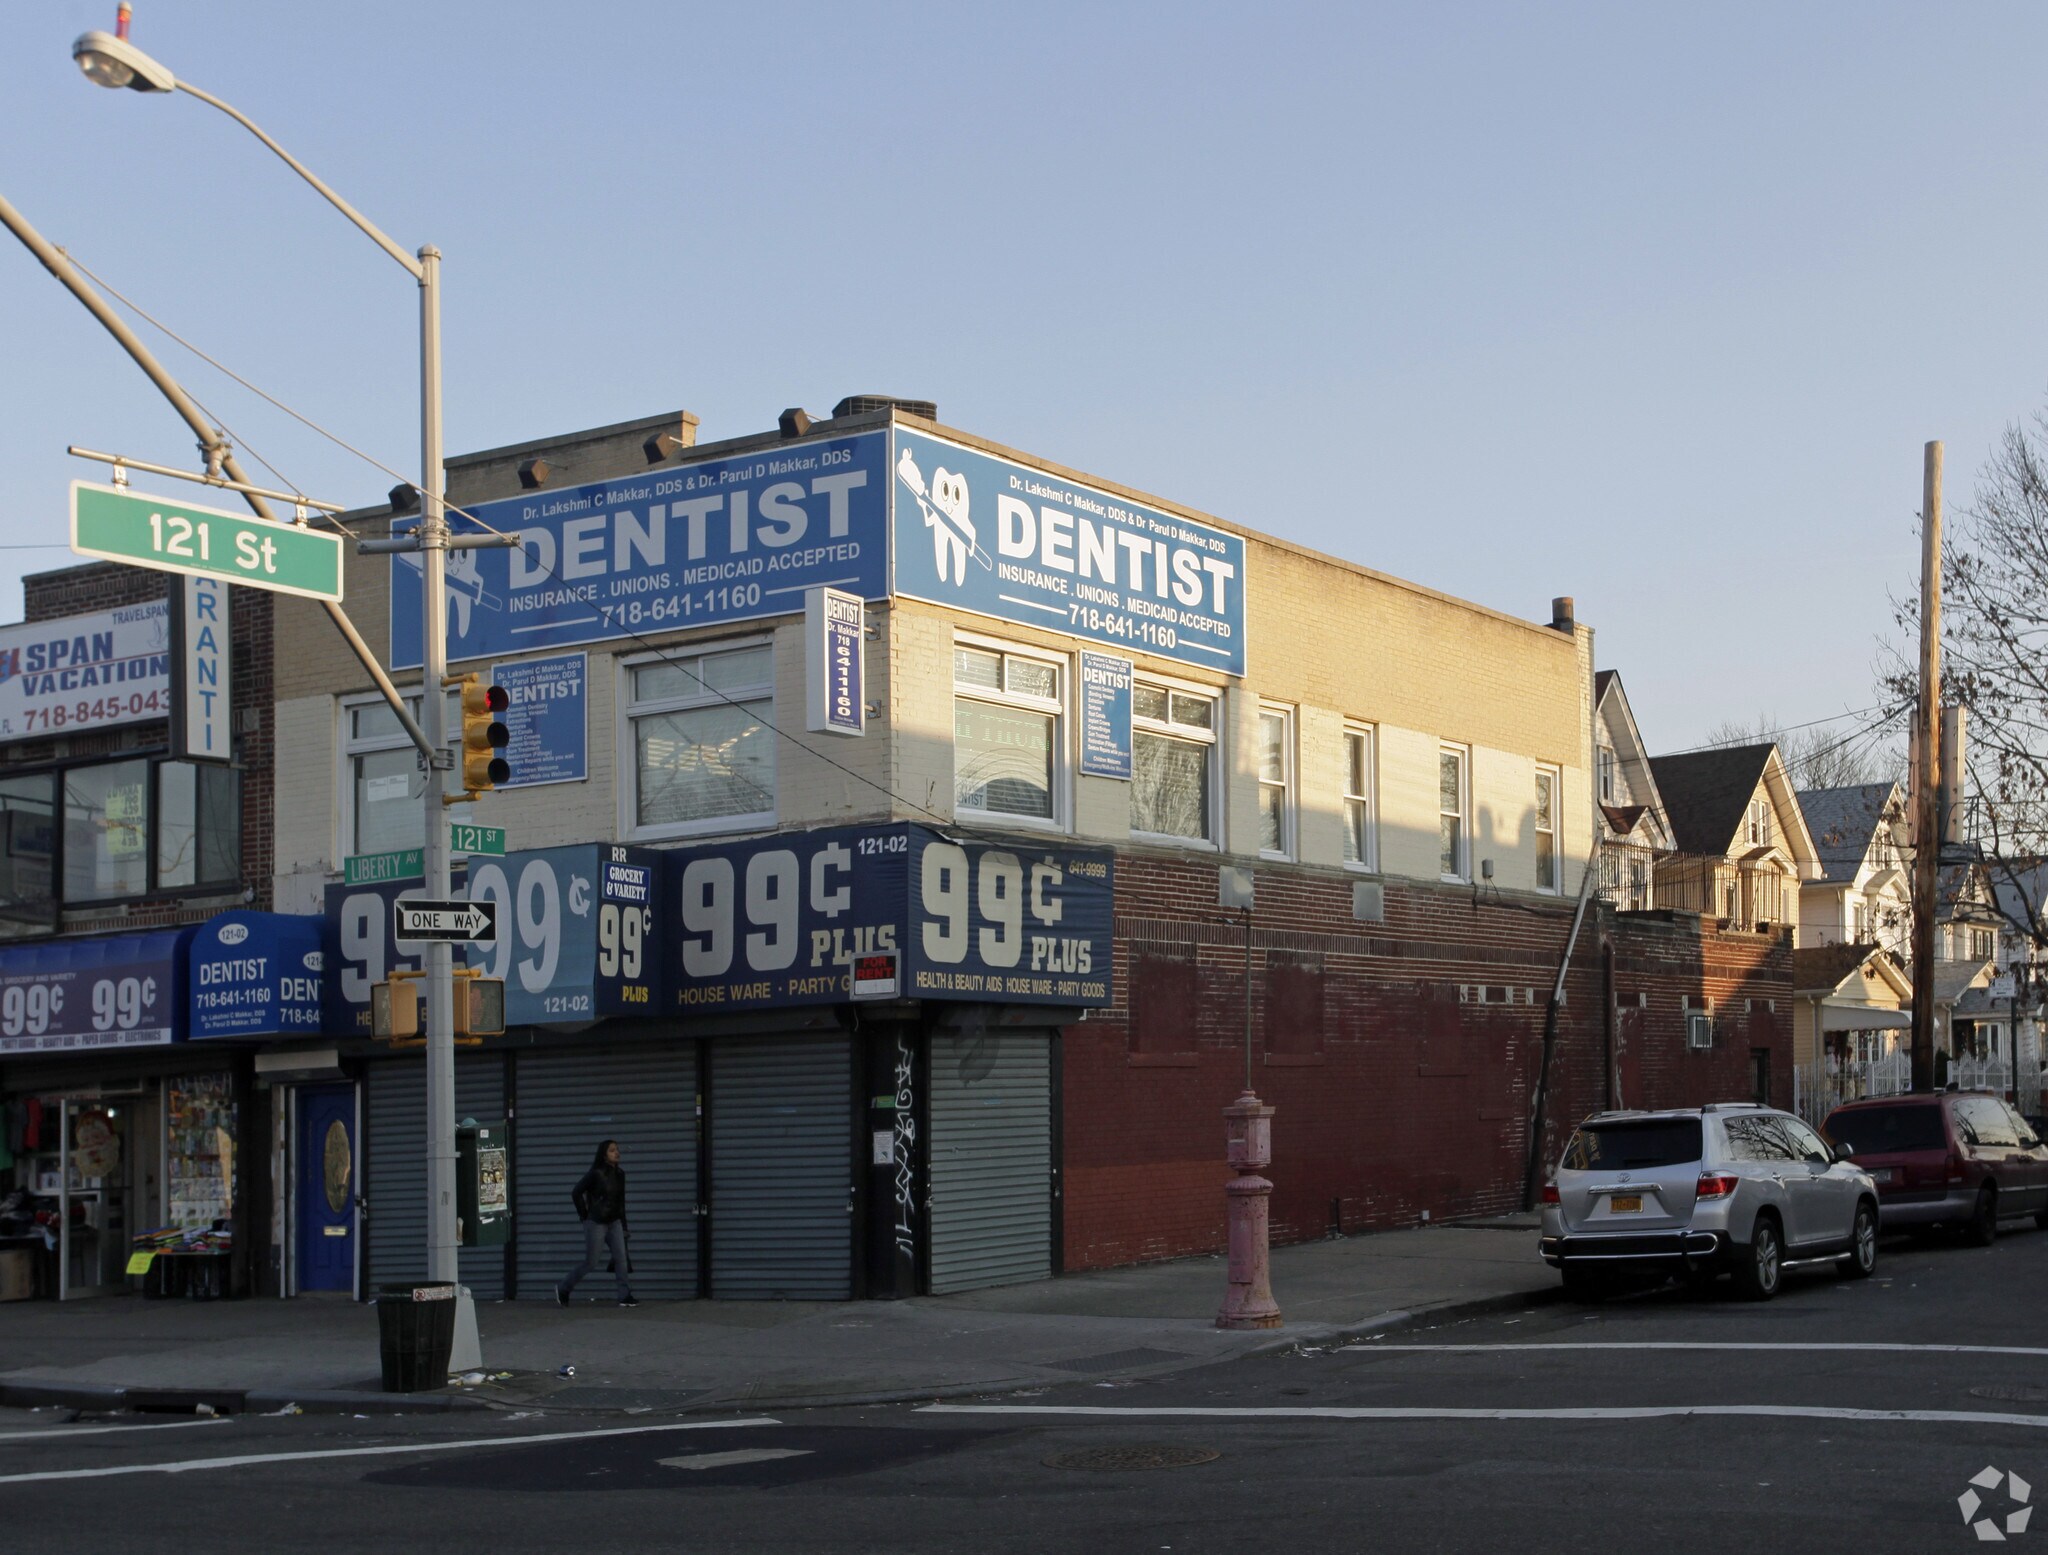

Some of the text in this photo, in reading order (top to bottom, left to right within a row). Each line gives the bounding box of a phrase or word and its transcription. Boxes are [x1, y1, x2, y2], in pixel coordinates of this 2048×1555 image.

[523, 449, 851, 520] Dr. Lakshmi C Makkar, DDS & Dr. Parul D Makkar, DDS
[1010, 475, 1023, 491] Dr.
[1025, 480, 1064, 502] Lakshmi
[1065, 493, 1072, 505] C
[1074, 494, 1107, 519] Makkar,
[1108, 506, 1126, 523] DDS
[1128, 512, 1134, 525] &
[1149, 518, 1170, 536] Parul
[1171, 526, 1178, 539] D
[1179, 528, 1208, 550] Makkar,
[1209, 538, 1226, 554] DDS
[509, 469, 867, 590] DENTIST
[150, 513, 277, 574] 121 St
[998, 494, 1234, 615] DENTIST
[510, 542, 860, 613] INSURANCE UNIONS MEDICAID ACCEPTED
[600, 582, 761, 629] 718-641-1160
[828, 598, 859, 624] DENTIST
[998, 563, 1231, 638] INSURANCE UNIONS MEDICAID ACCEPTED
[112, 604, 168, 625] TRAVELSPAN
[1069, 603, 1176, 649] 718-641-1160
[828, 621, 859, 638] Dr. Makkar
[837, 635, 850, 646] 718
[26, 631, 113, 673] SPAN
[497, 660, 582, 680] Dr. Lakshmi C Makkar, DDS
[502, 680, 511, 688] Dr.
[513, 677, 530, 687] Parul
[537, 672, 560, 682] Makkar,
[562, 670, 577, 679] DDS
[1084, 667, 1130, 690] DENTIST
[457, 827, 497, 850] 121 ST
[858, 835, 907, 855] 121-02
[611, 847, 627, 862] RR
[351, 852, 418, 881] LIBERTY AV
[609, 866, 645, 885] GROCERY
[1068, 860, 1106, 878] 641-9999
[606, 882, 647, 900] & VARIETY
[412, 912, 482, 929] ONE WAY
[221, 928, 246, 940] 121-02
[863, 956, 887, 968] FOR
[1031, 936, 1091, 974] PLUS
[200, 958, 267, 985] DENTIST
[856, 967, 893, 980] RENT
[622, 985, 649, 1003] PLUS
[678, 986, 725, 1005] HOUSE
[730, 982, 771, 1001] WARE
[789, 976, 836, 995] PARTY
[916, 971, 1105, 998] HEALTH & BEAUTY AIDS HOUSE WARE PARTY GOODS
[197, 988, 271, 1009] 718-641-1160
[544, 995, 589, 1013] 121-02
